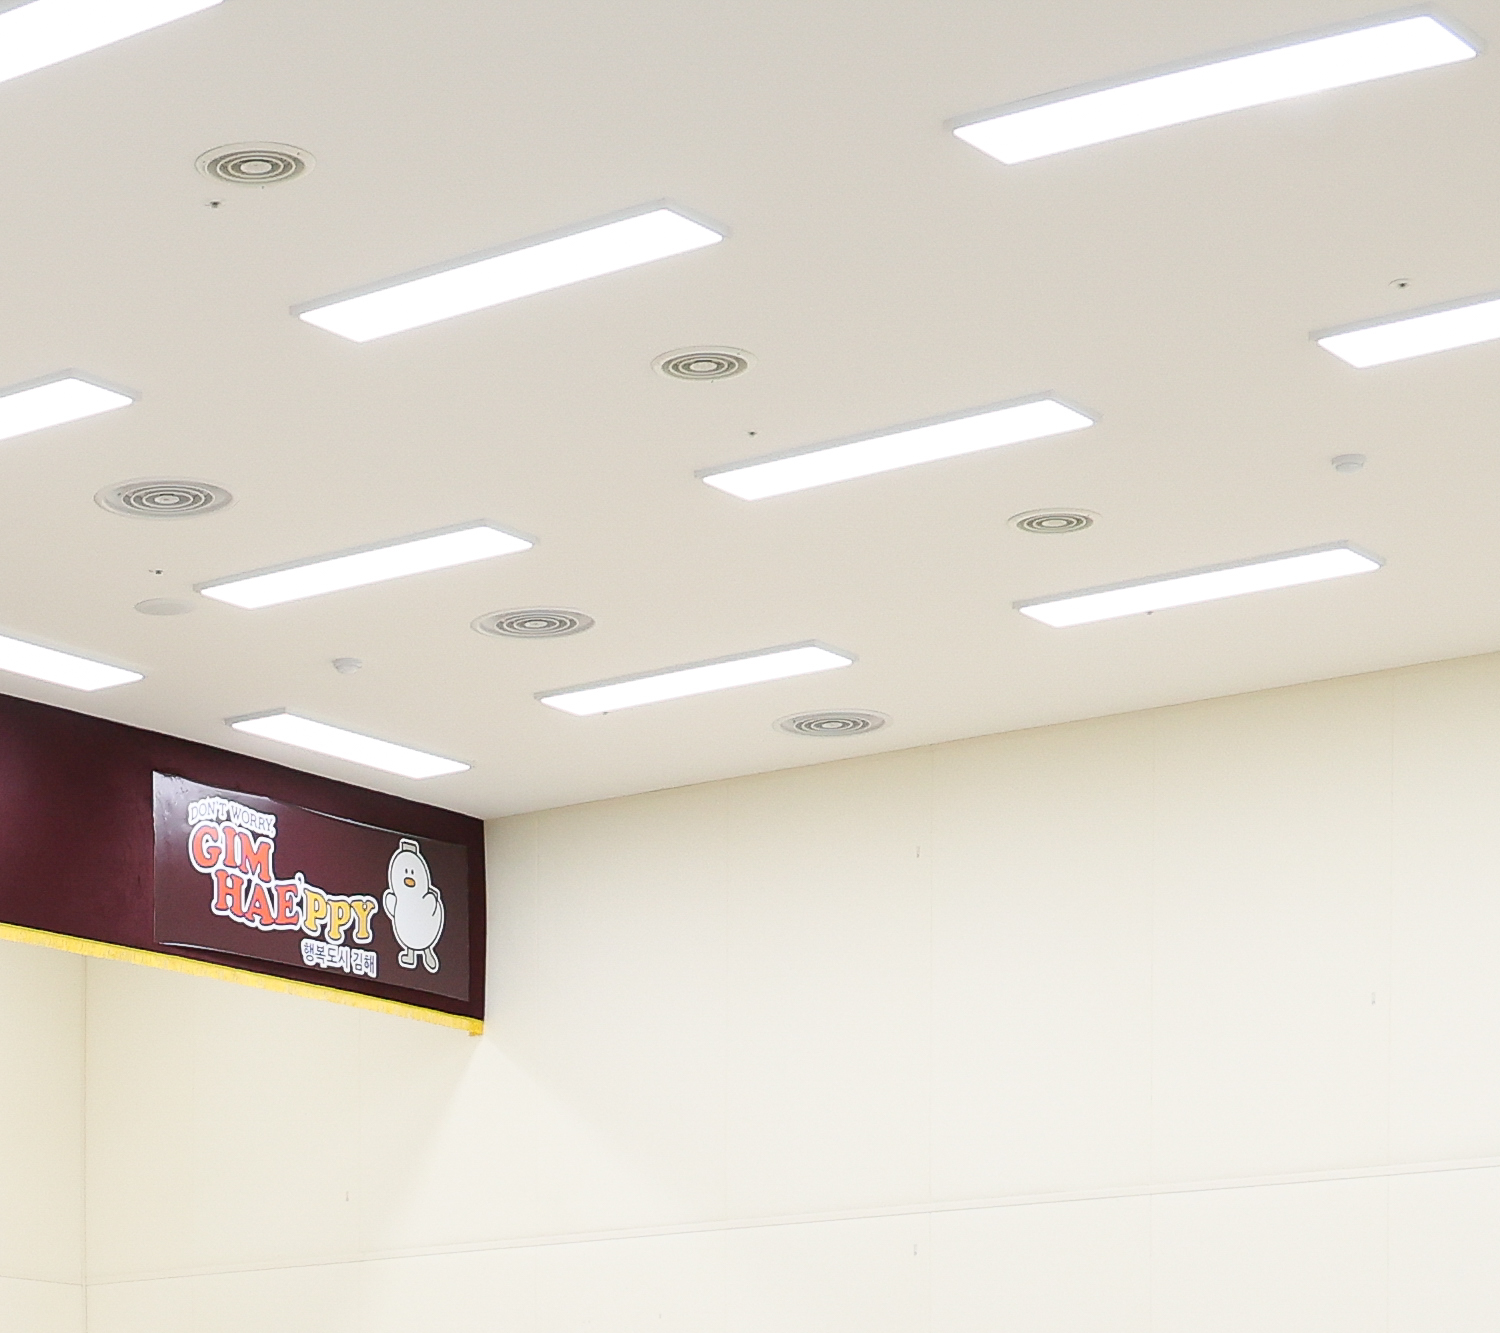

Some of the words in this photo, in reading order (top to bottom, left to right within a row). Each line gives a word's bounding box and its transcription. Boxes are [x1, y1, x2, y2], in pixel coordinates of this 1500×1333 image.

[190, 801, 227, 821] DON'T
[192, 825, 272, 883] GIM
[303, 942, 349, 970] 행복도시
[353, 952, 375, 975] 김해
